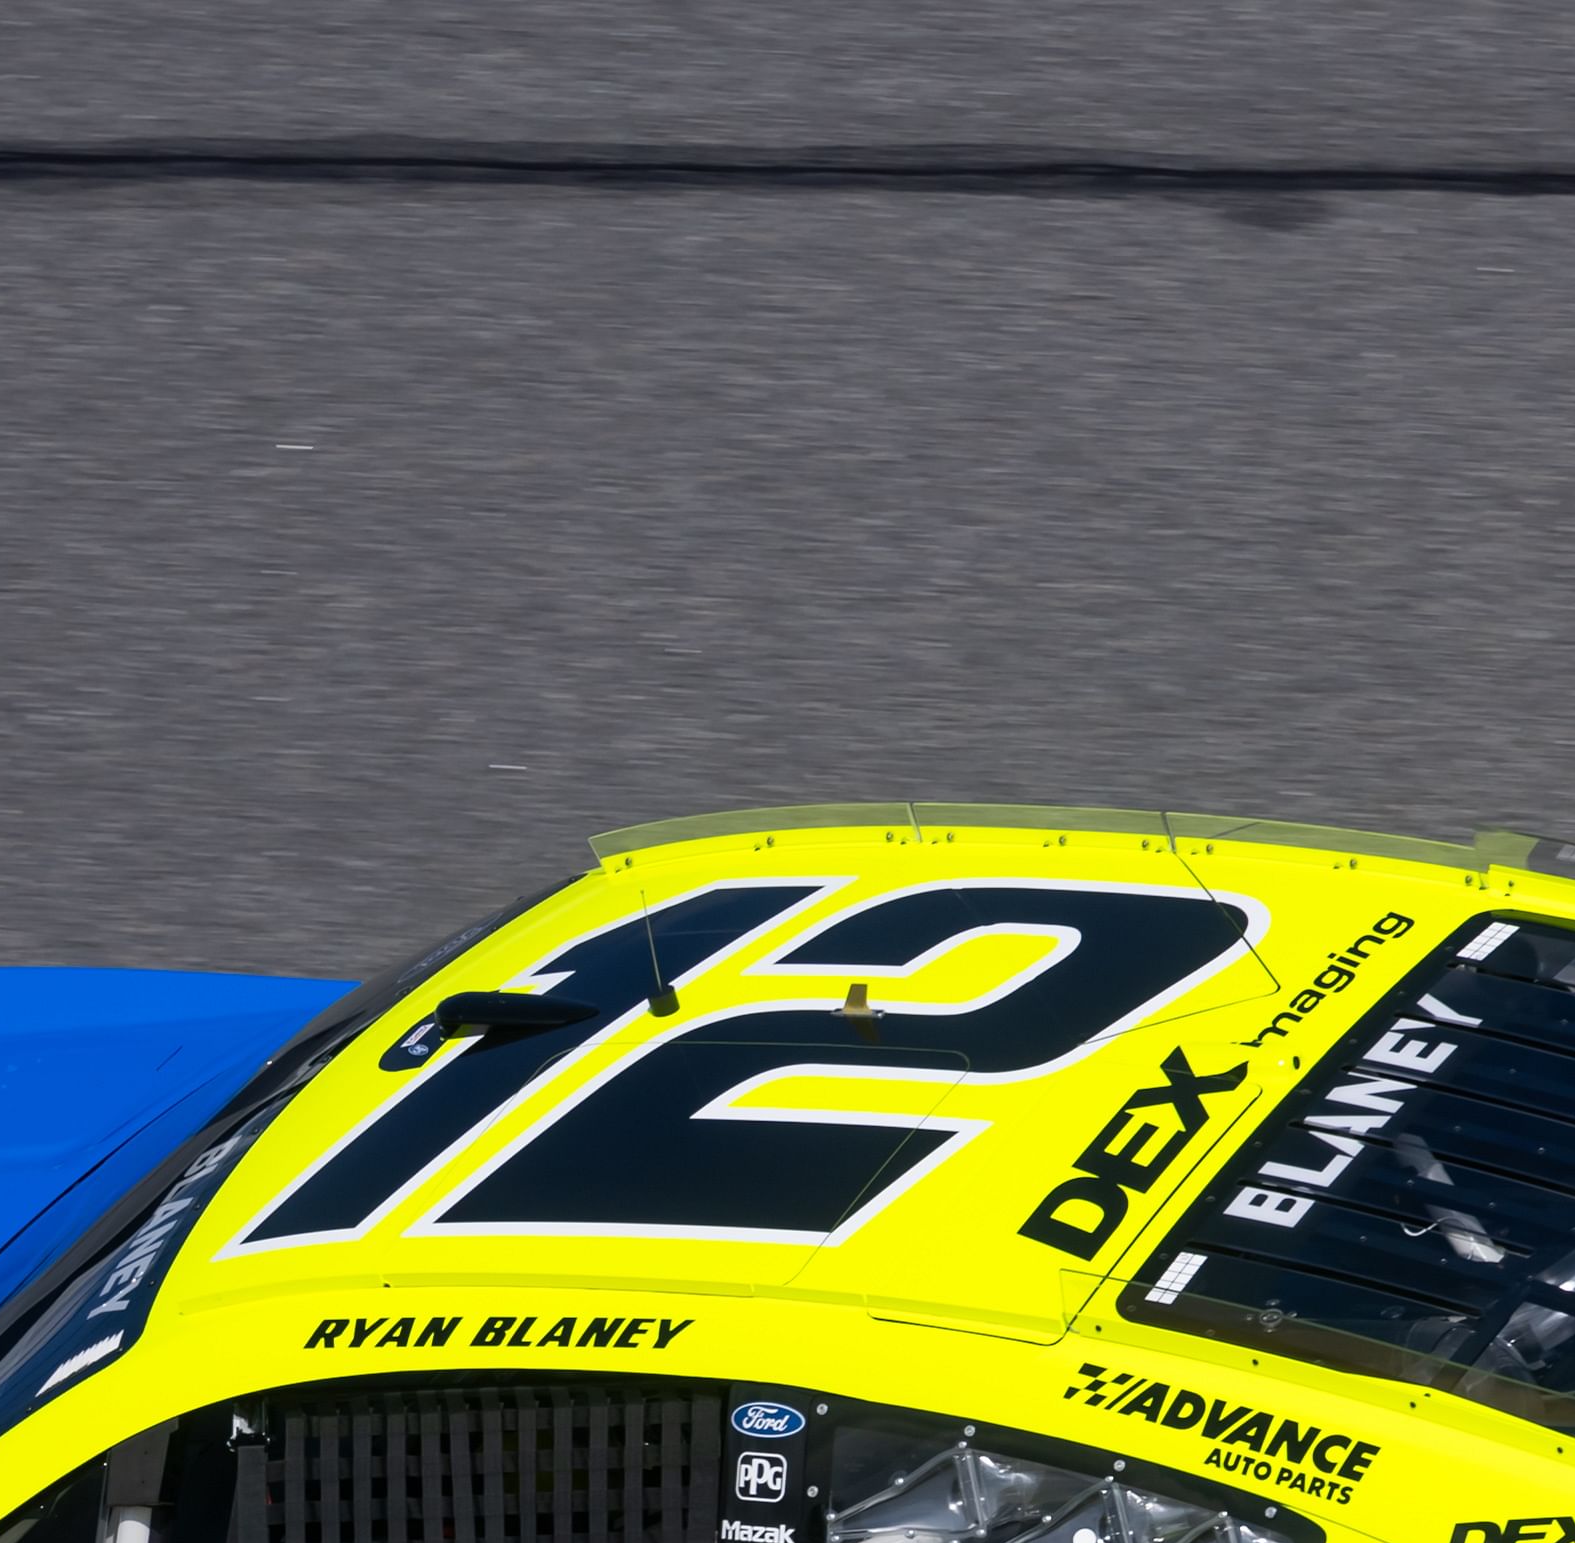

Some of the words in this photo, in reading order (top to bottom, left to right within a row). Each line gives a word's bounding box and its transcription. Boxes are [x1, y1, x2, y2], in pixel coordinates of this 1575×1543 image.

[1231, 911, 1416, 1048] maging
[211, 876, 1271, 1262] 12
[1223, 993, 1483, 1228] BLANEY
[1017, 1045, 1249, 1262] DEX
[304, 1316, 464, 1349] RYAN
[470, 1316, 696, 1349] BLANEY
[742, 1406, 790, 1431] Ford
[1125, 1381, 1381, 1482] ADVANCE
[739, 1458, 783, 1495] PPG
[1204, 1448, 1272, 1481] AUTO
[1275, 1467, 1353, 1505] PARTS
